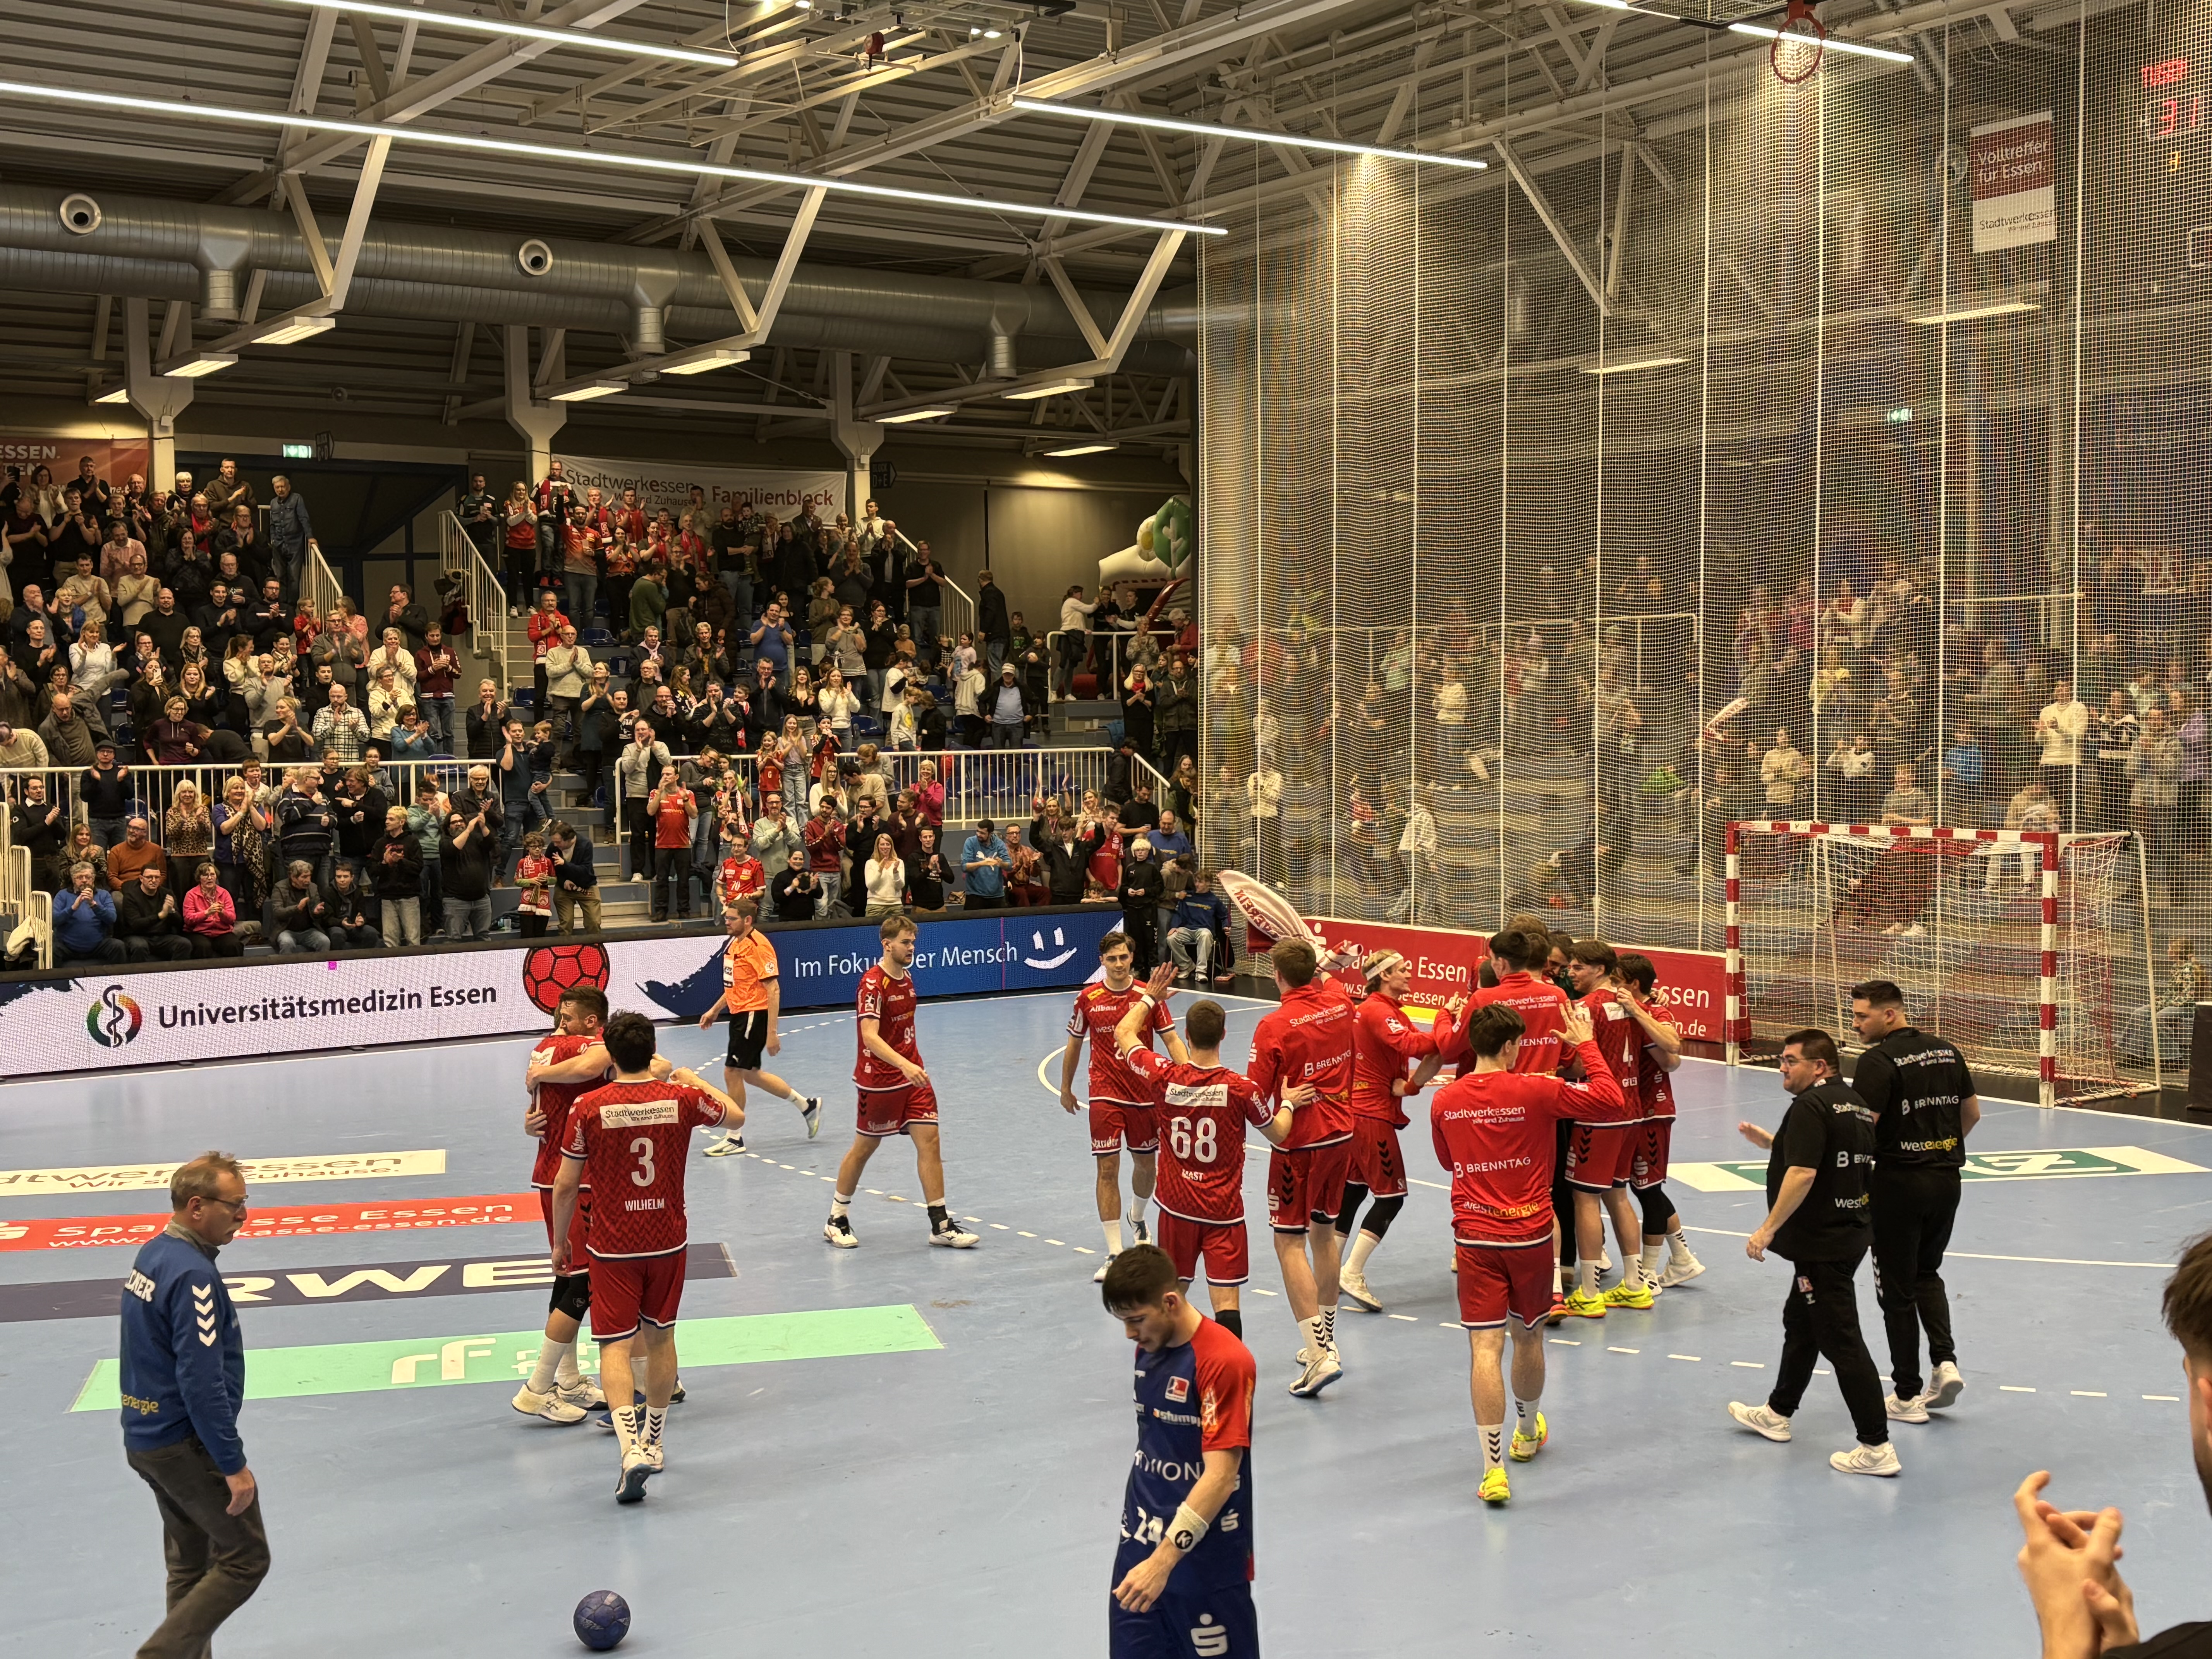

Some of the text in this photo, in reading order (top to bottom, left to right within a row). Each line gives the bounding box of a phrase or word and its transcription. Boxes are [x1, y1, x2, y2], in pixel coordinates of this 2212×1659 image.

[1977, 140, 2048, 165] Volltreffer
[566, 469, 695, 494] Stadtwerkessen
[872, 473, 888, 488] D+E
[712, 486, 833, 506] Familienblock
[731, 880, 741, 891] 70
[795, 957, 821, 978] Im
[941, 941, 1017, 967] Mensch
[1417, 957, 1467, 983] Essen
[158, 983, 497, 1029] Universitätsmedizin Essen
[1651, 979, 1709, 1008] ssen
[1444, 1106, 1525, 1121] Stadtwerkessen
[1170, 1116, 1217, 1163] 68
[630, 1137, 655, 1187] 3
[1467, 1157, 1531, 1173] BRENNTAG
[1182, 1168, 1204, 1182] MAST
[360, 1202, 513, 1220] Essen
[625, 1198, 665, 1211] WILHELM
[222, 1259, 556, 1302] RWE
